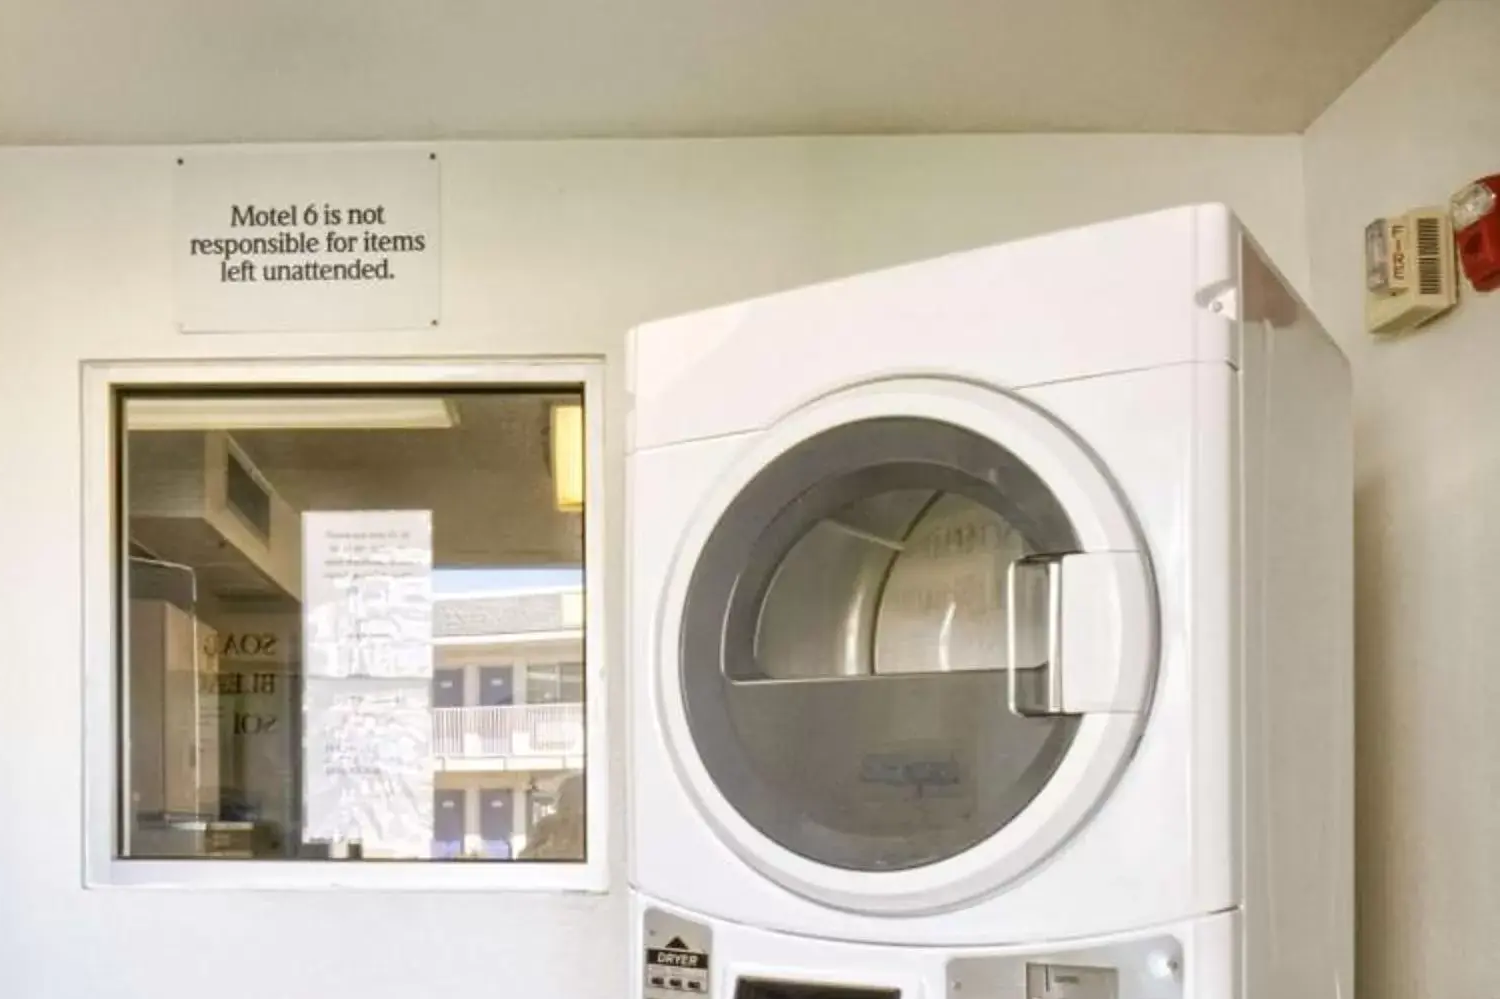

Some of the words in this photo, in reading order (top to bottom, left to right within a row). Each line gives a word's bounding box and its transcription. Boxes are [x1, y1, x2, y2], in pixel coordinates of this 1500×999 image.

[230, 204, 297, 227] Motel
[303, 203, 319, 226] 6
[323, 203, 342, 226] is
[347, 204, 386, 226] not
[190, 231, 320, 260] responsible
[326, 231, 358, 253] for
[363, 231, 426, 253] items
[220, 259, 256, 282] left
[263, 258, 395, 281] unattended.
[657, 951, 699, 967] DRYER
